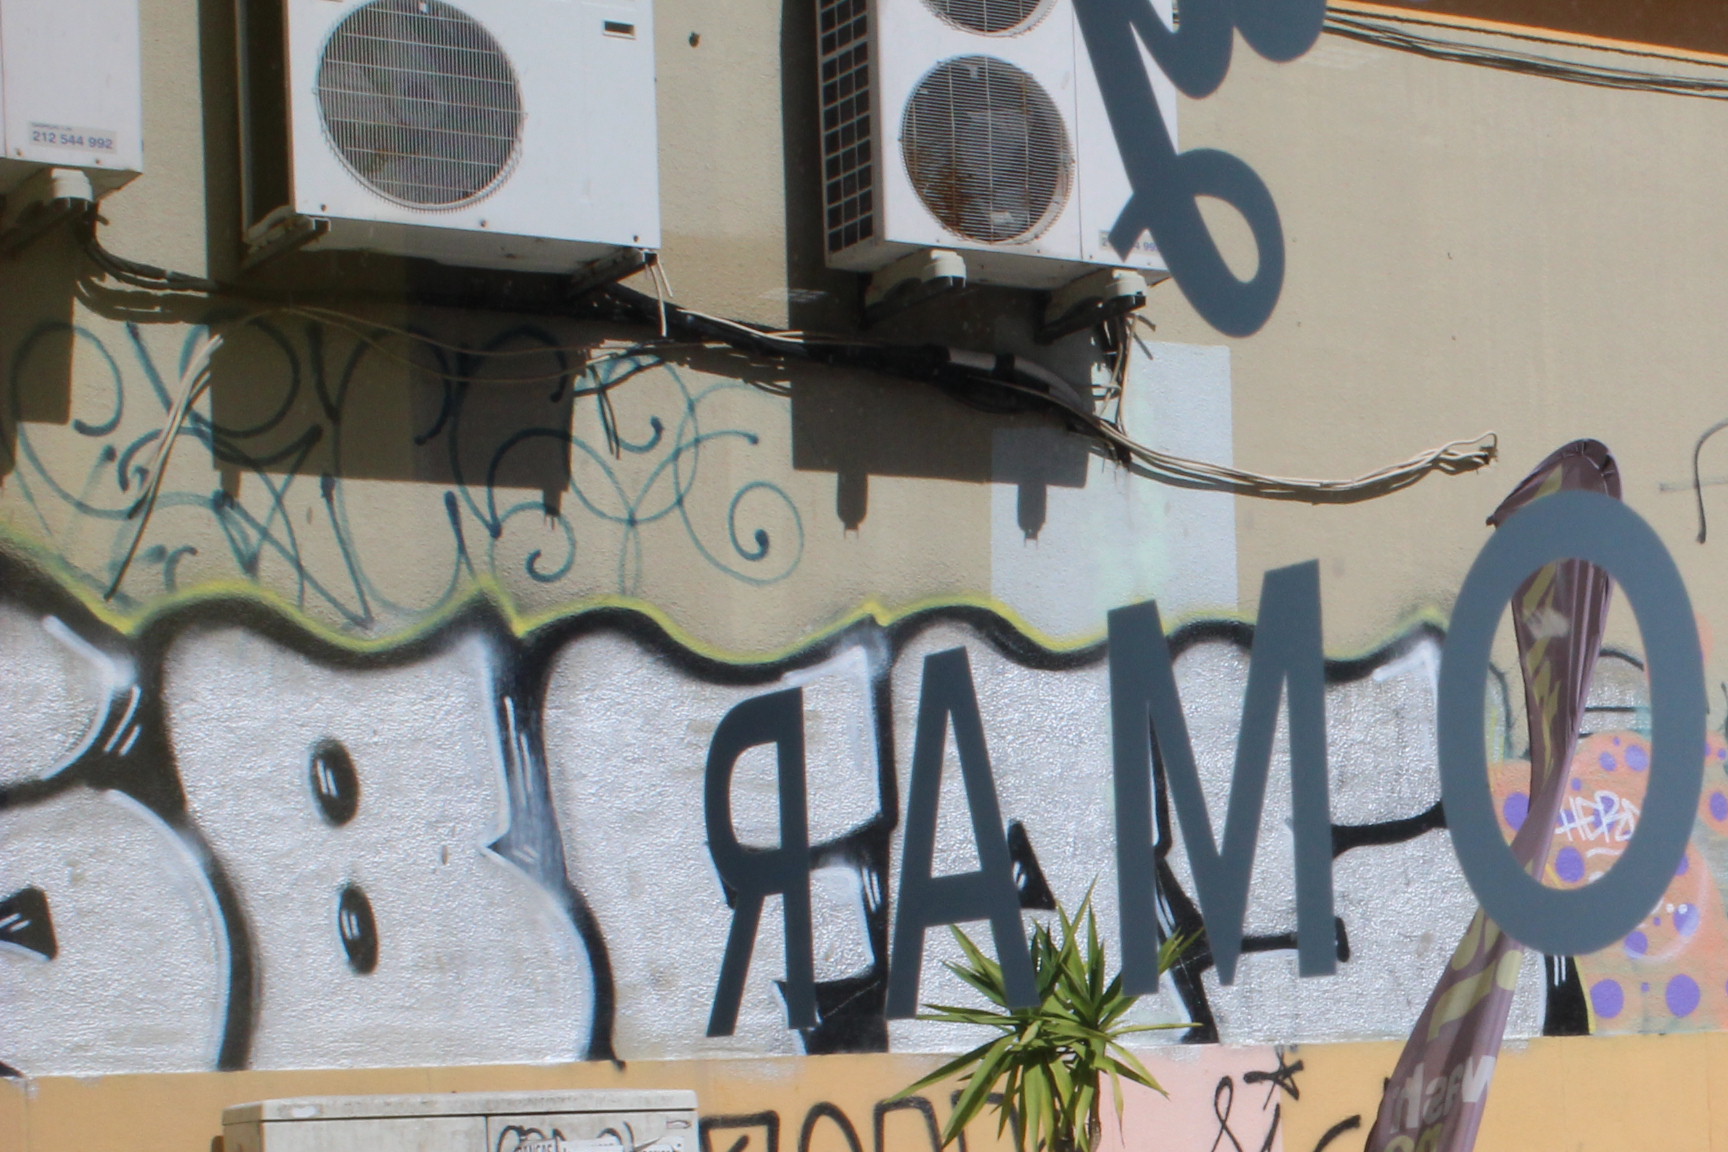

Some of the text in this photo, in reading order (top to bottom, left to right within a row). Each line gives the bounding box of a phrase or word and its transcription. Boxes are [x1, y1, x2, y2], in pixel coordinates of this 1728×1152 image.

[32, 130, 113, 149] 212 544 992
